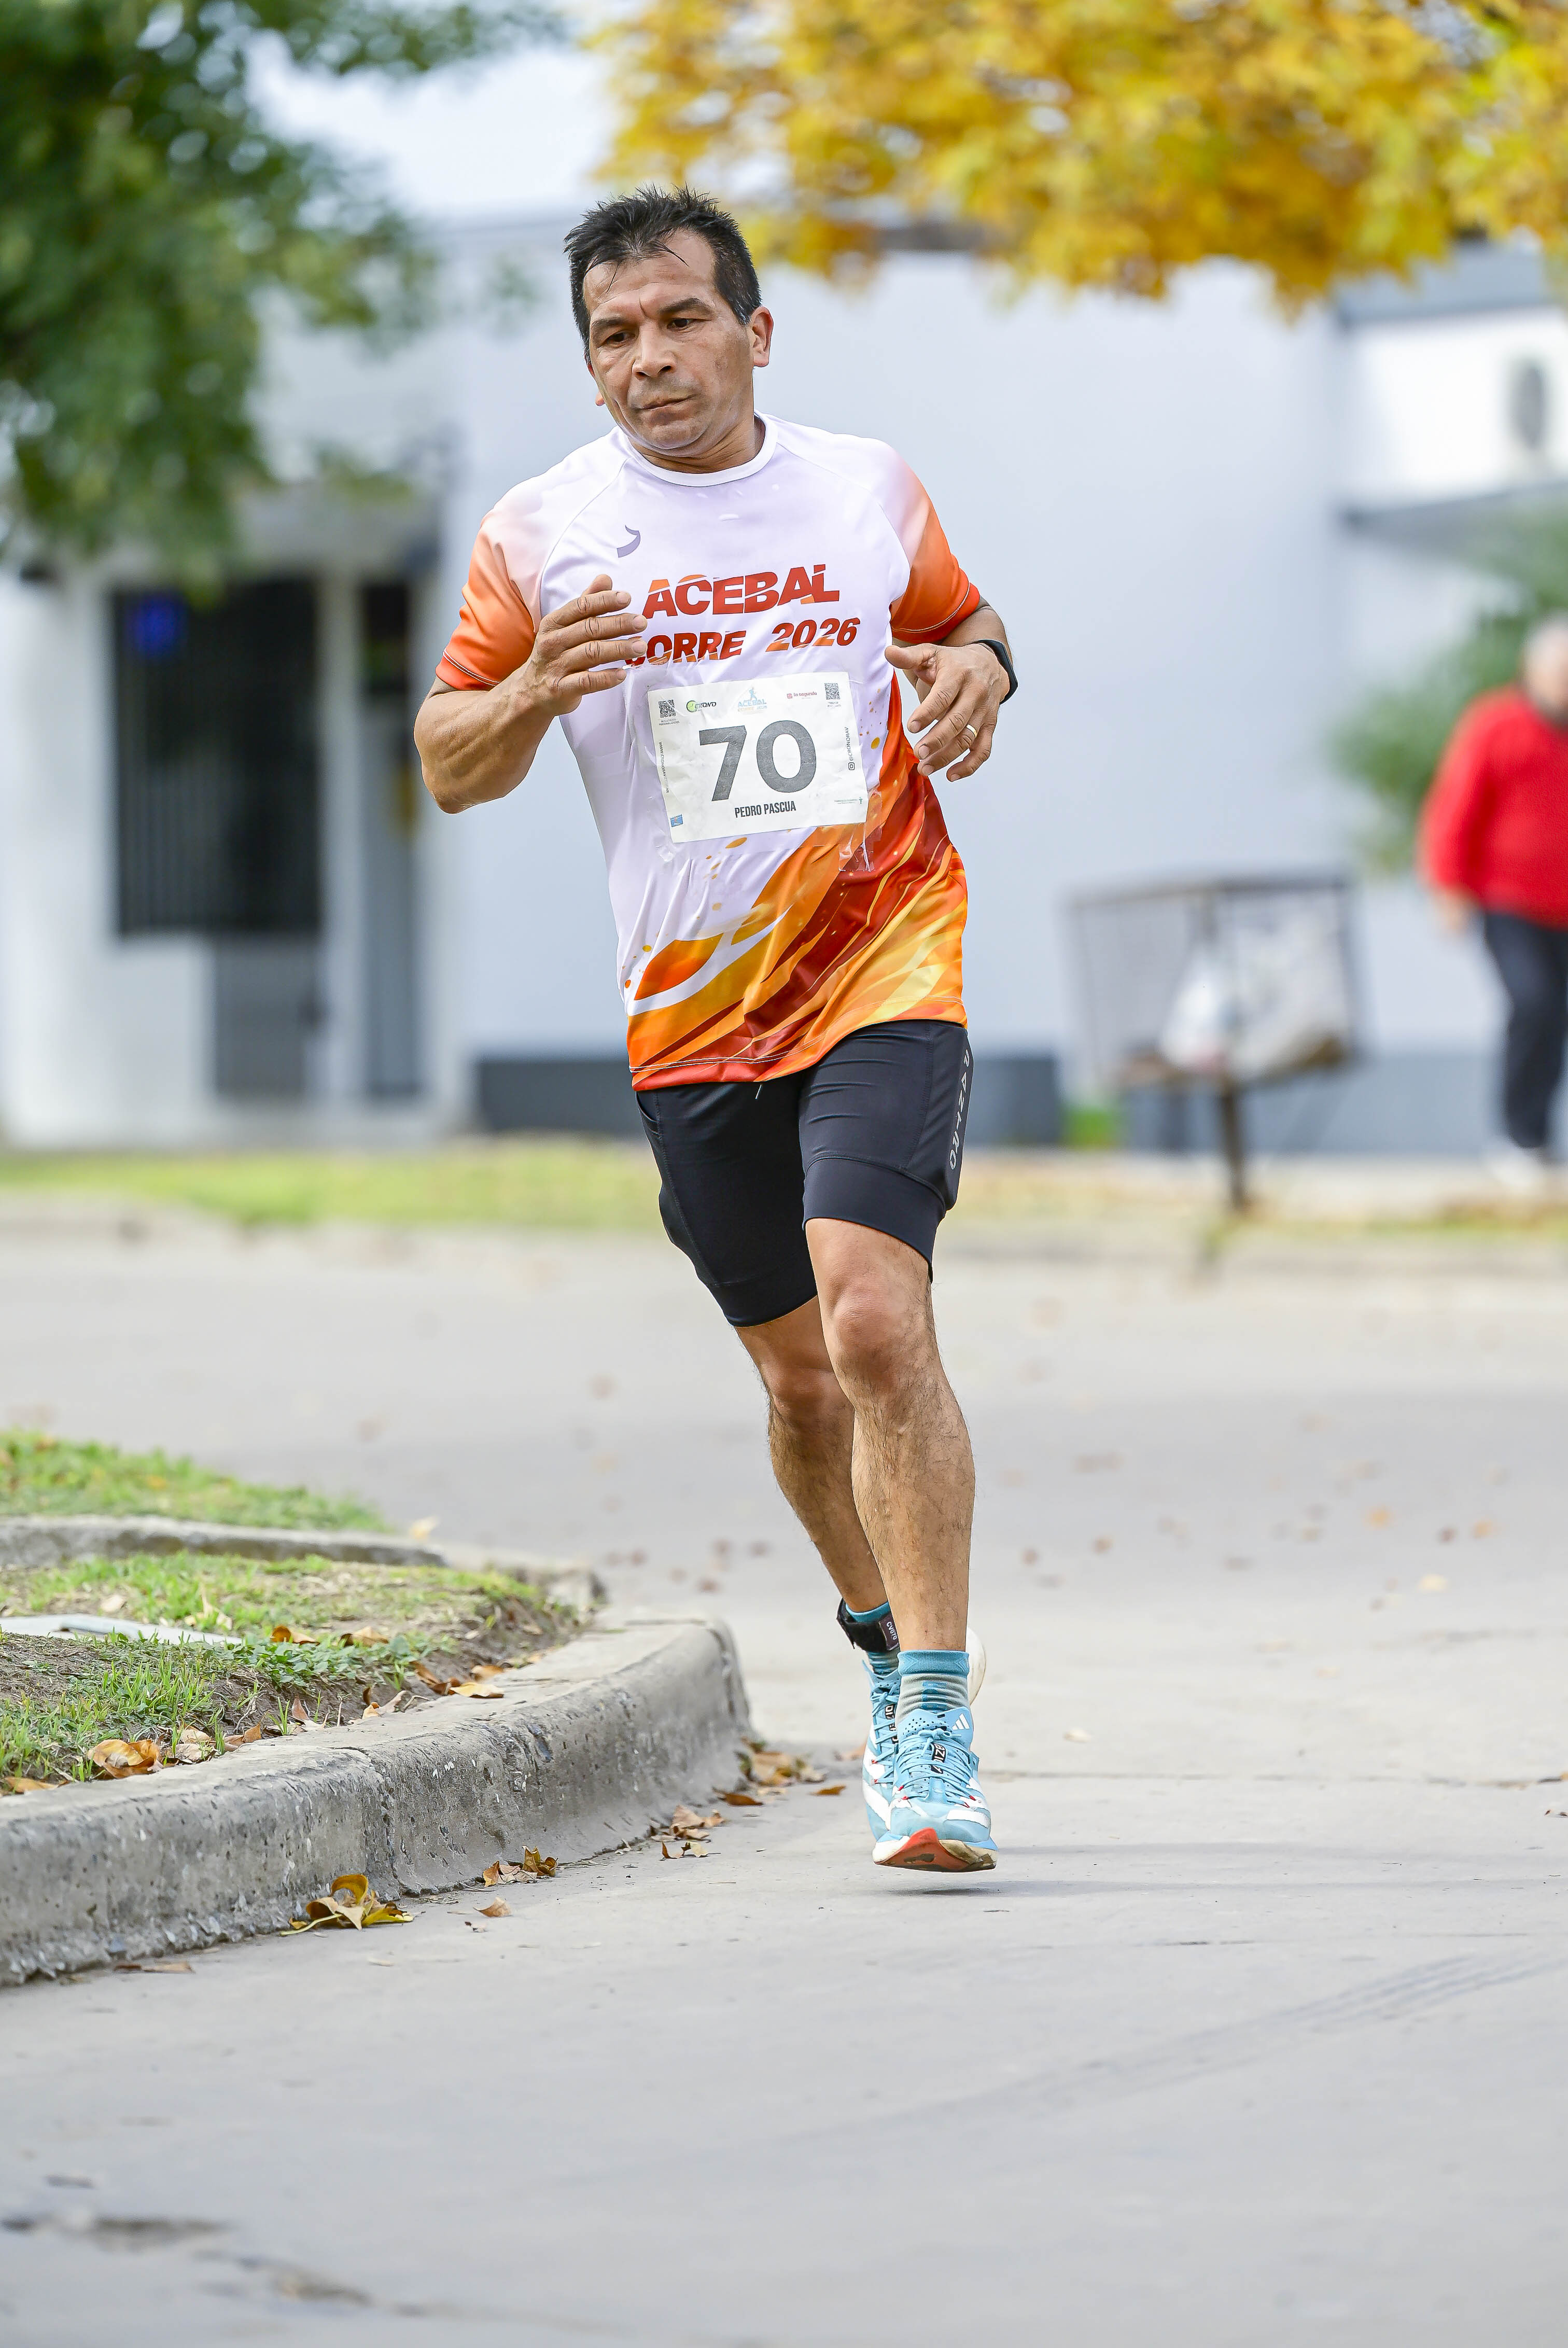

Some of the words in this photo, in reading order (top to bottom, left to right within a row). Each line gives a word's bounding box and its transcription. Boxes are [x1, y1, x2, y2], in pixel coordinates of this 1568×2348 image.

[642, 564, 839, 619] ACEBAL
[765, 618, 860, 652] 2026
[699, 720, 817, 802] 70
[845, 727, 853, 761] @CRONORAV
[735, 805, 762, 818] PEDRO
[763, 801, 796, 815] PASCUA
